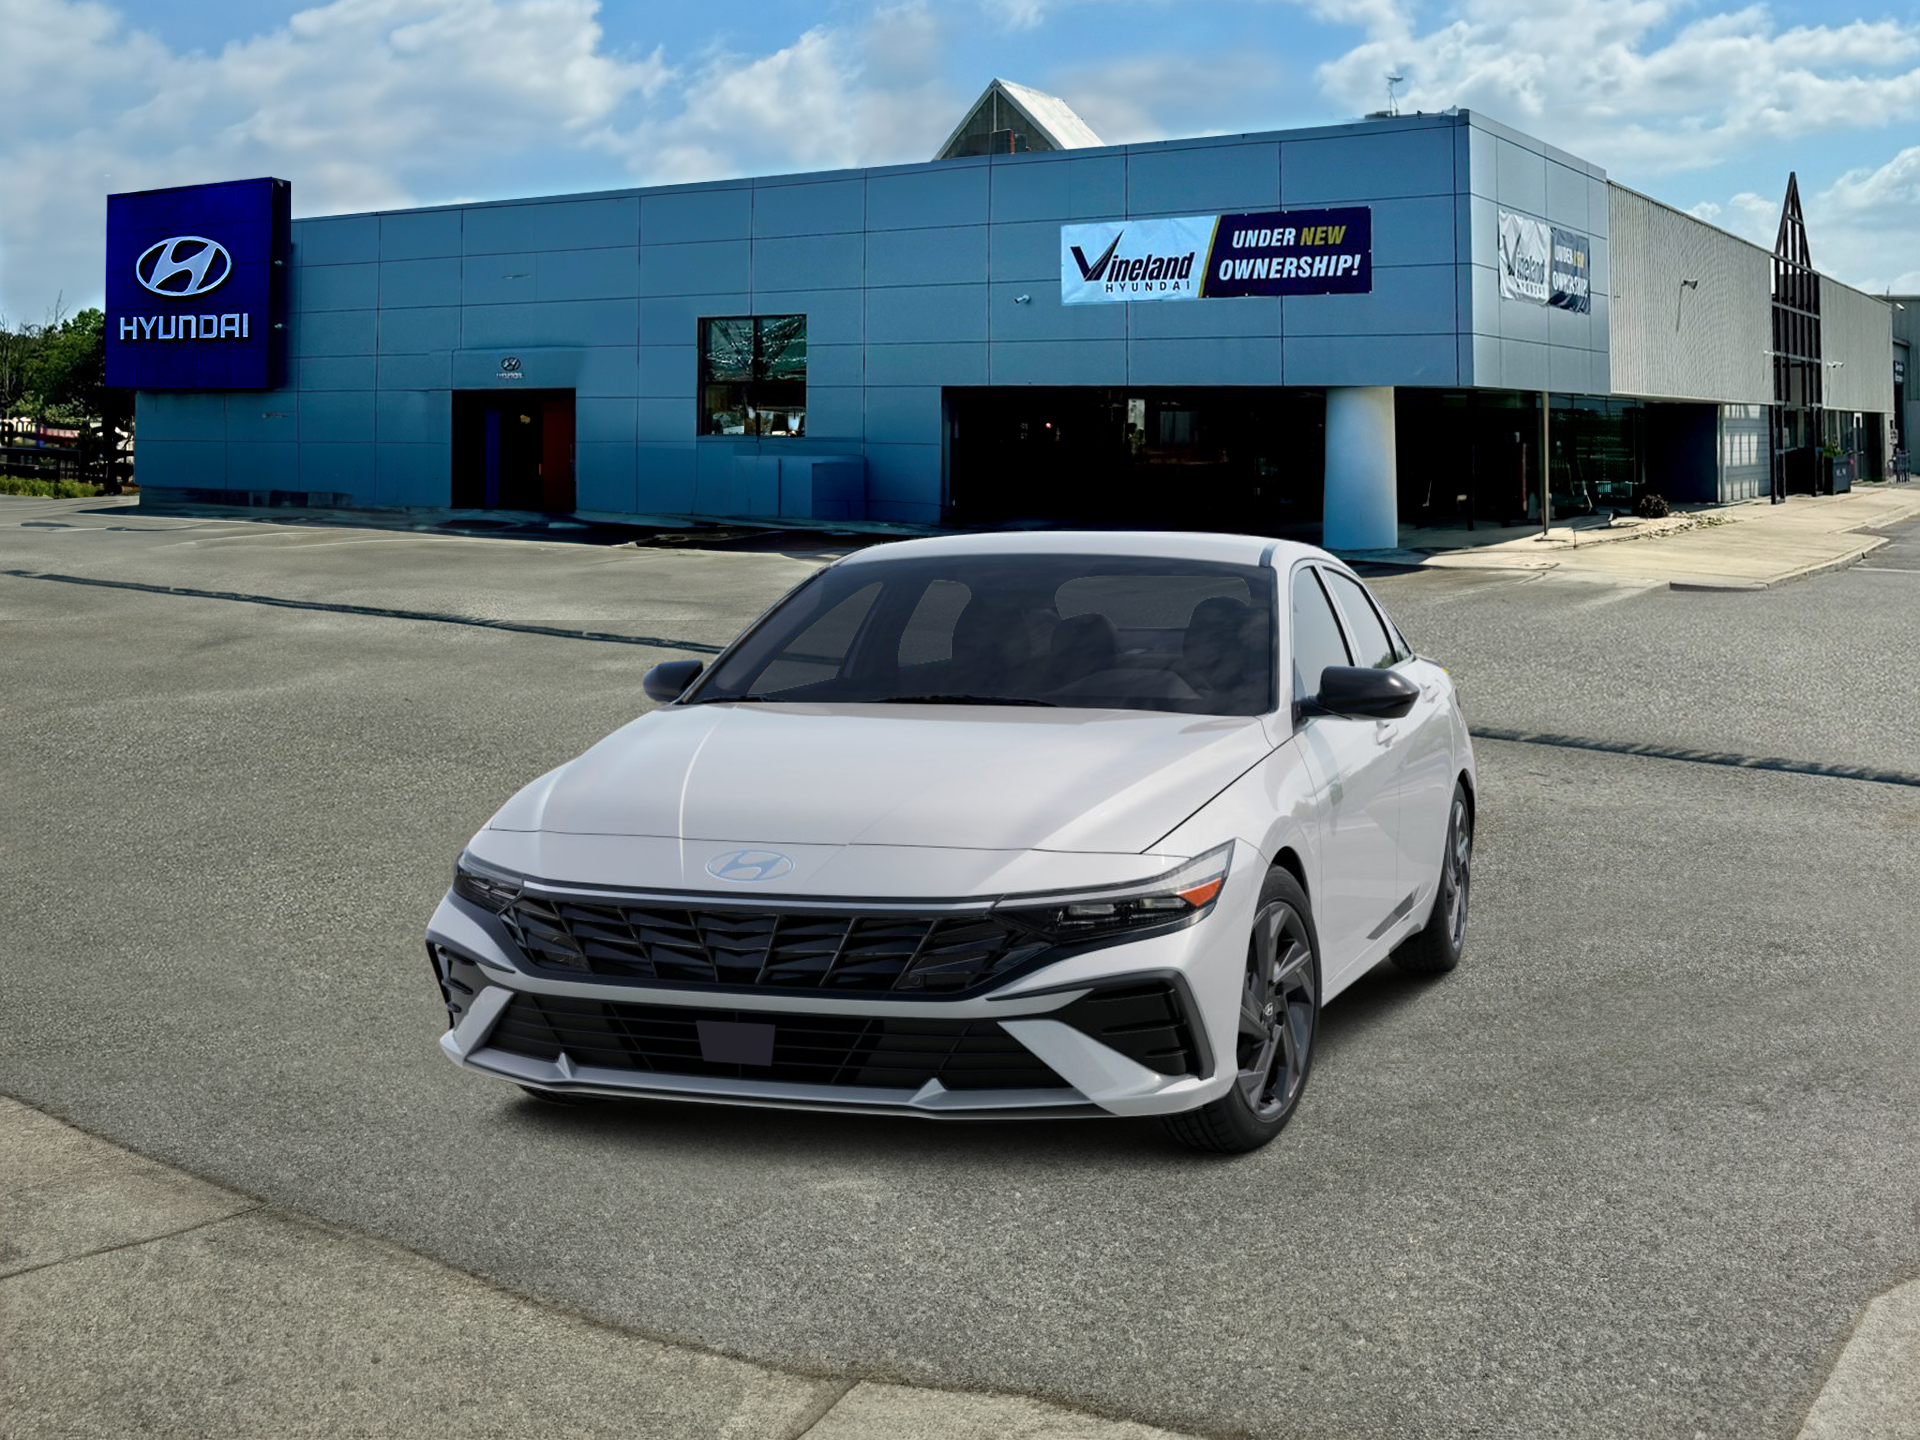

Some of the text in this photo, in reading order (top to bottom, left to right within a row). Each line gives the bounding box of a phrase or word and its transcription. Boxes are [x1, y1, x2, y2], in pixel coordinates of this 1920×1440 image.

[1232, 225, 1346, 249] UNDER NEW
[1070, 229, 1195, 282] Vineland
[1219, 254, 1361, 281] OWNERSHIP!
[1105, 280, 1191, 293] HYUNDAI
[119, 312, 249, 340] HYUNDAI
